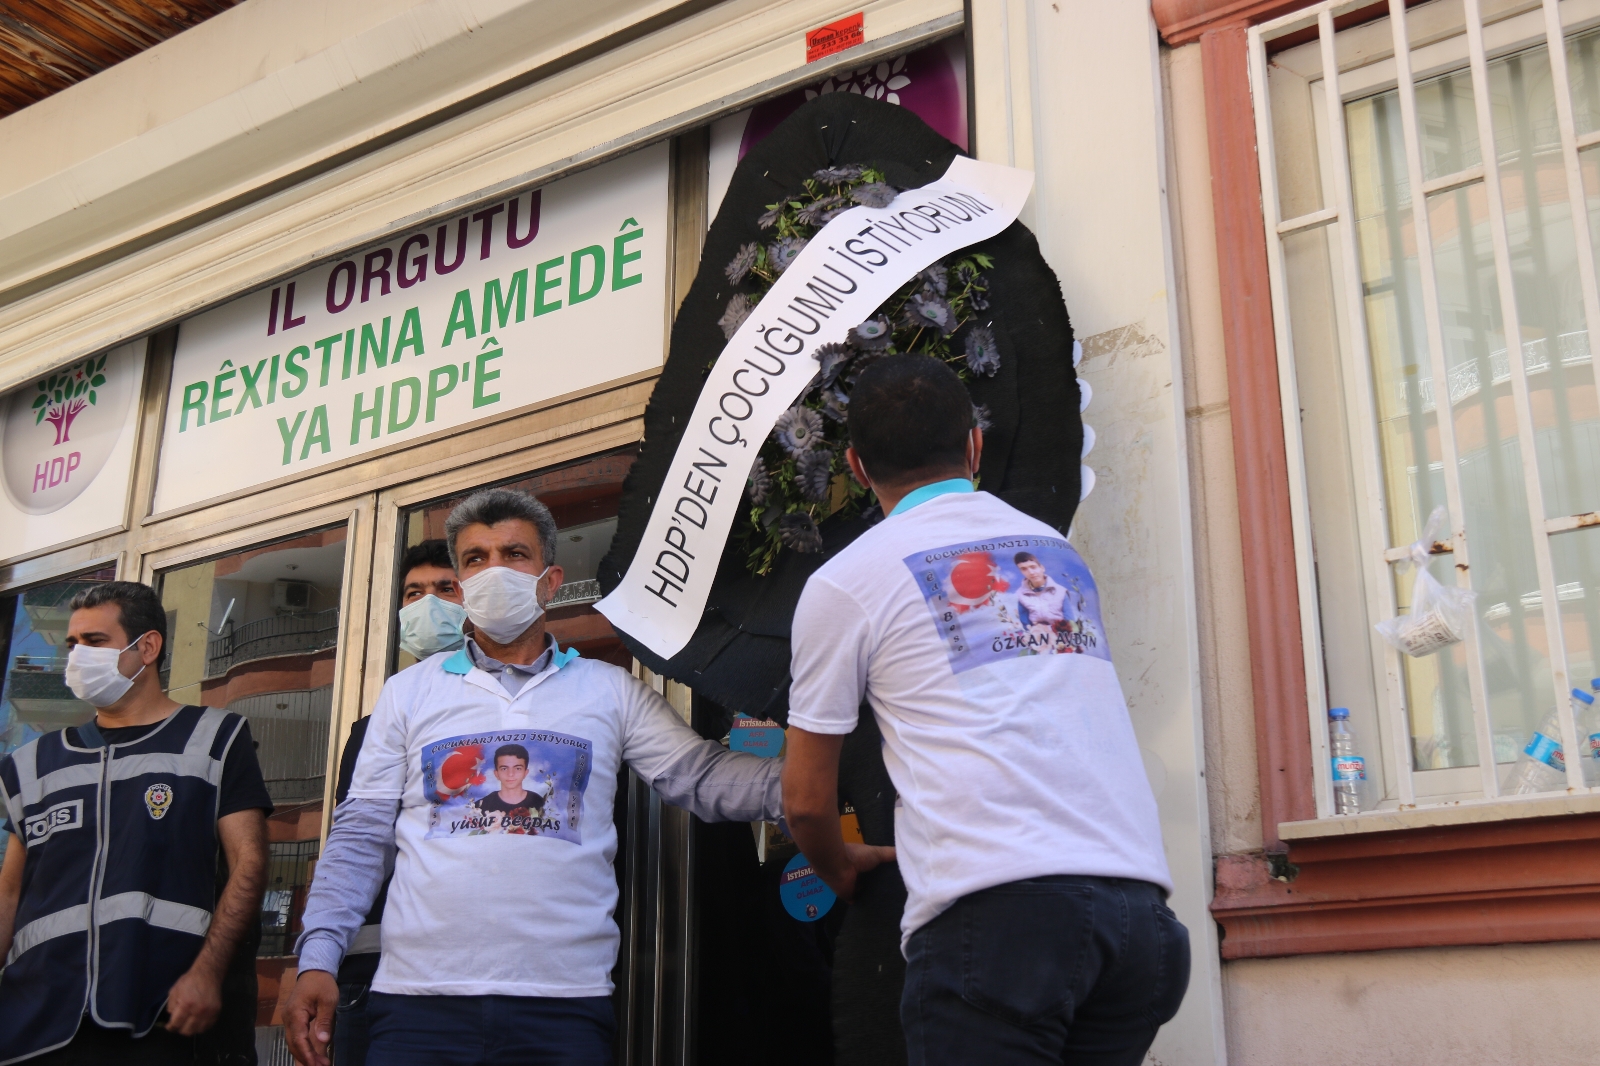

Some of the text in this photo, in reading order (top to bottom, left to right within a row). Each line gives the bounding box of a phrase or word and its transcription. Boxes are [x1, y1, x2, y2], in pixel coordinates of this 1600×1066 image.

[179, 217, 644, 432] RÊXISTINA AMEDÊ
[276, 338, 503, 466] YA HDP'Ê
[644, 191, 995, 607] HDP'DEN ÇOCUĞUMU İSTİYORUM
[32, 452, 81, 493] HDP
[992, 633, 1050, 652] ÖZKAN
[796, 885, 824, 899] OLMAZ
